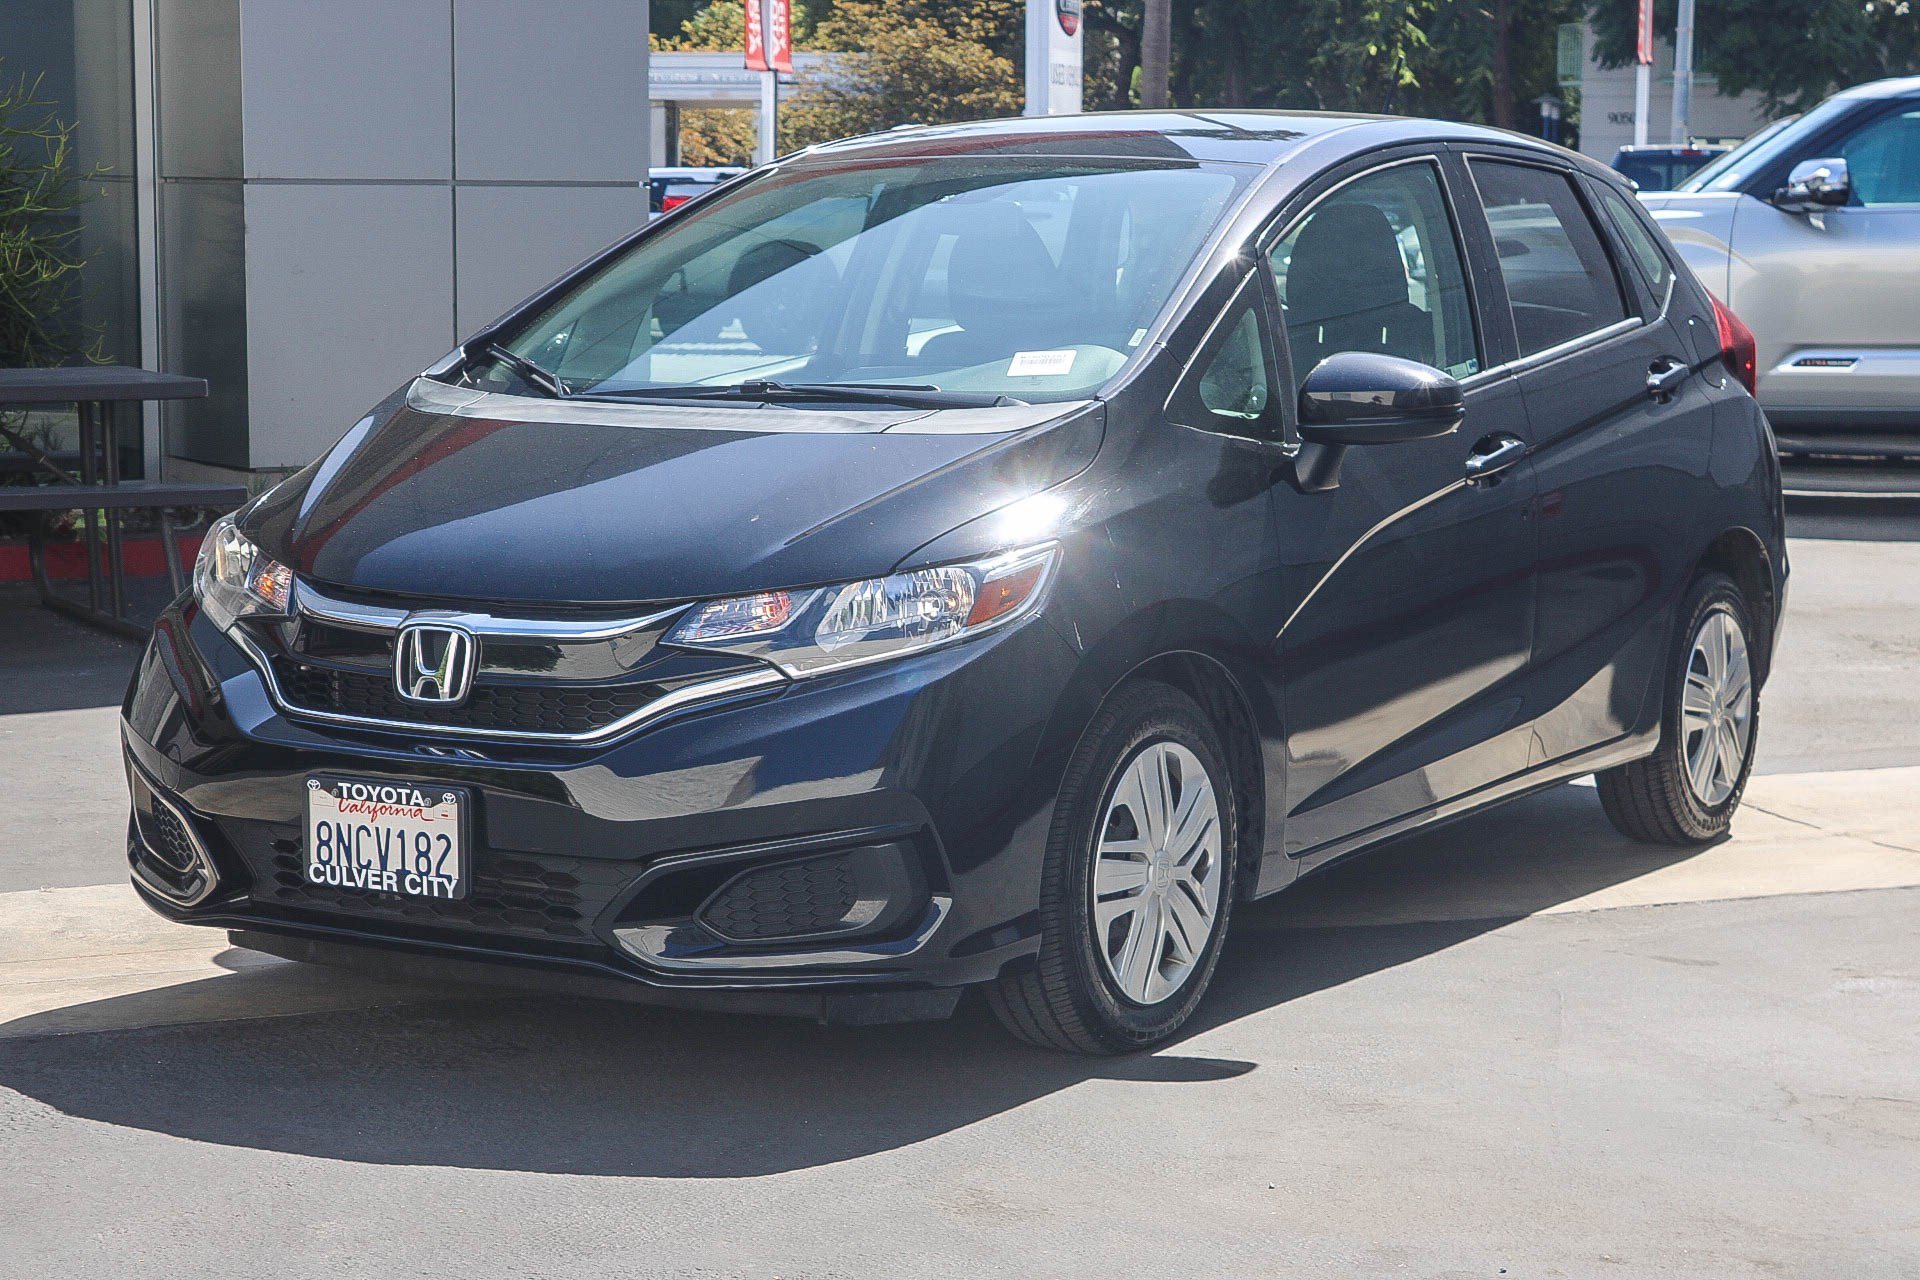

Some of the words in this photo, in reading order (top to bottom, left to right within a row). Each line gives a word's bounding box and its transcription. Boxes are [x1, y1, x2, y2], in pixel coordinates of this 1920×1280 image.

[337, 782, 425, 806] TOYOTA
[338, 798, 434, 823] California
[316, 820, 452, 882] 8NCV182
[308, 863, 399, 892] CULVER
[404, 873, 458, 899] CITY
